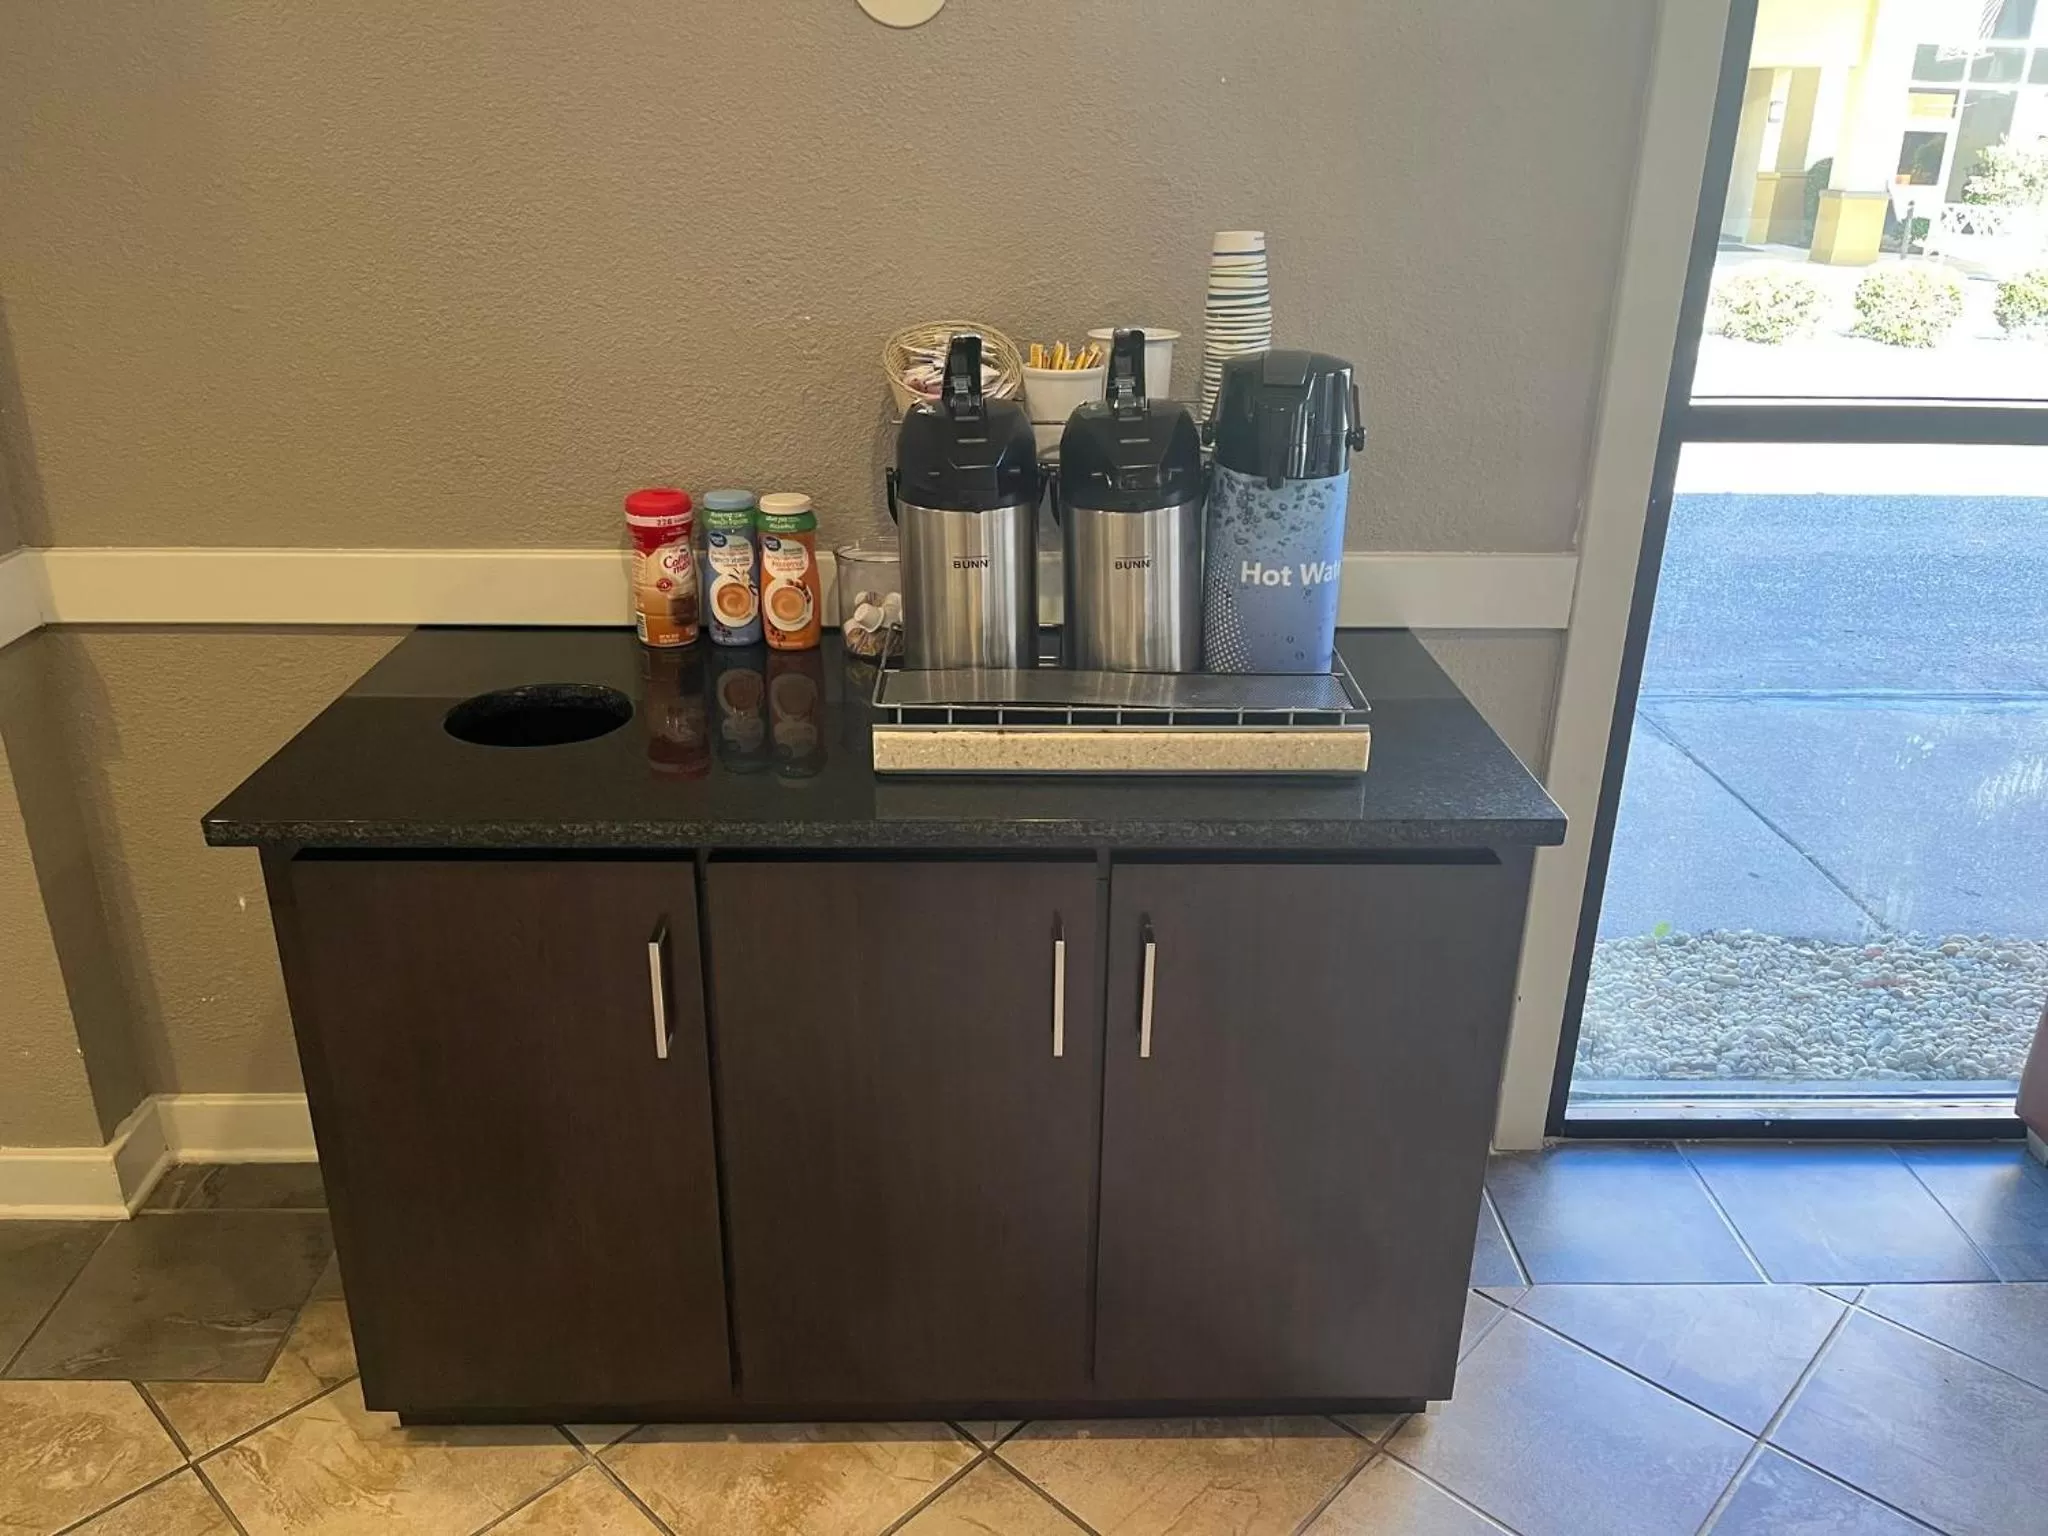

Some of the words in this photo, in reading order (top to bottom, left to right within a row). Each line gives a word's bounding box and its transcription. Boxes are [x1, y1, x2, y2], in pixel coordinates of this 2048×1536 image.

[953, 559, 989, 569] BUNN
[1115, 560, 1151, 570] BUNN
[1240, 560, 1293, 587] Hot
[1299, 560, 1340, 586] Wat
